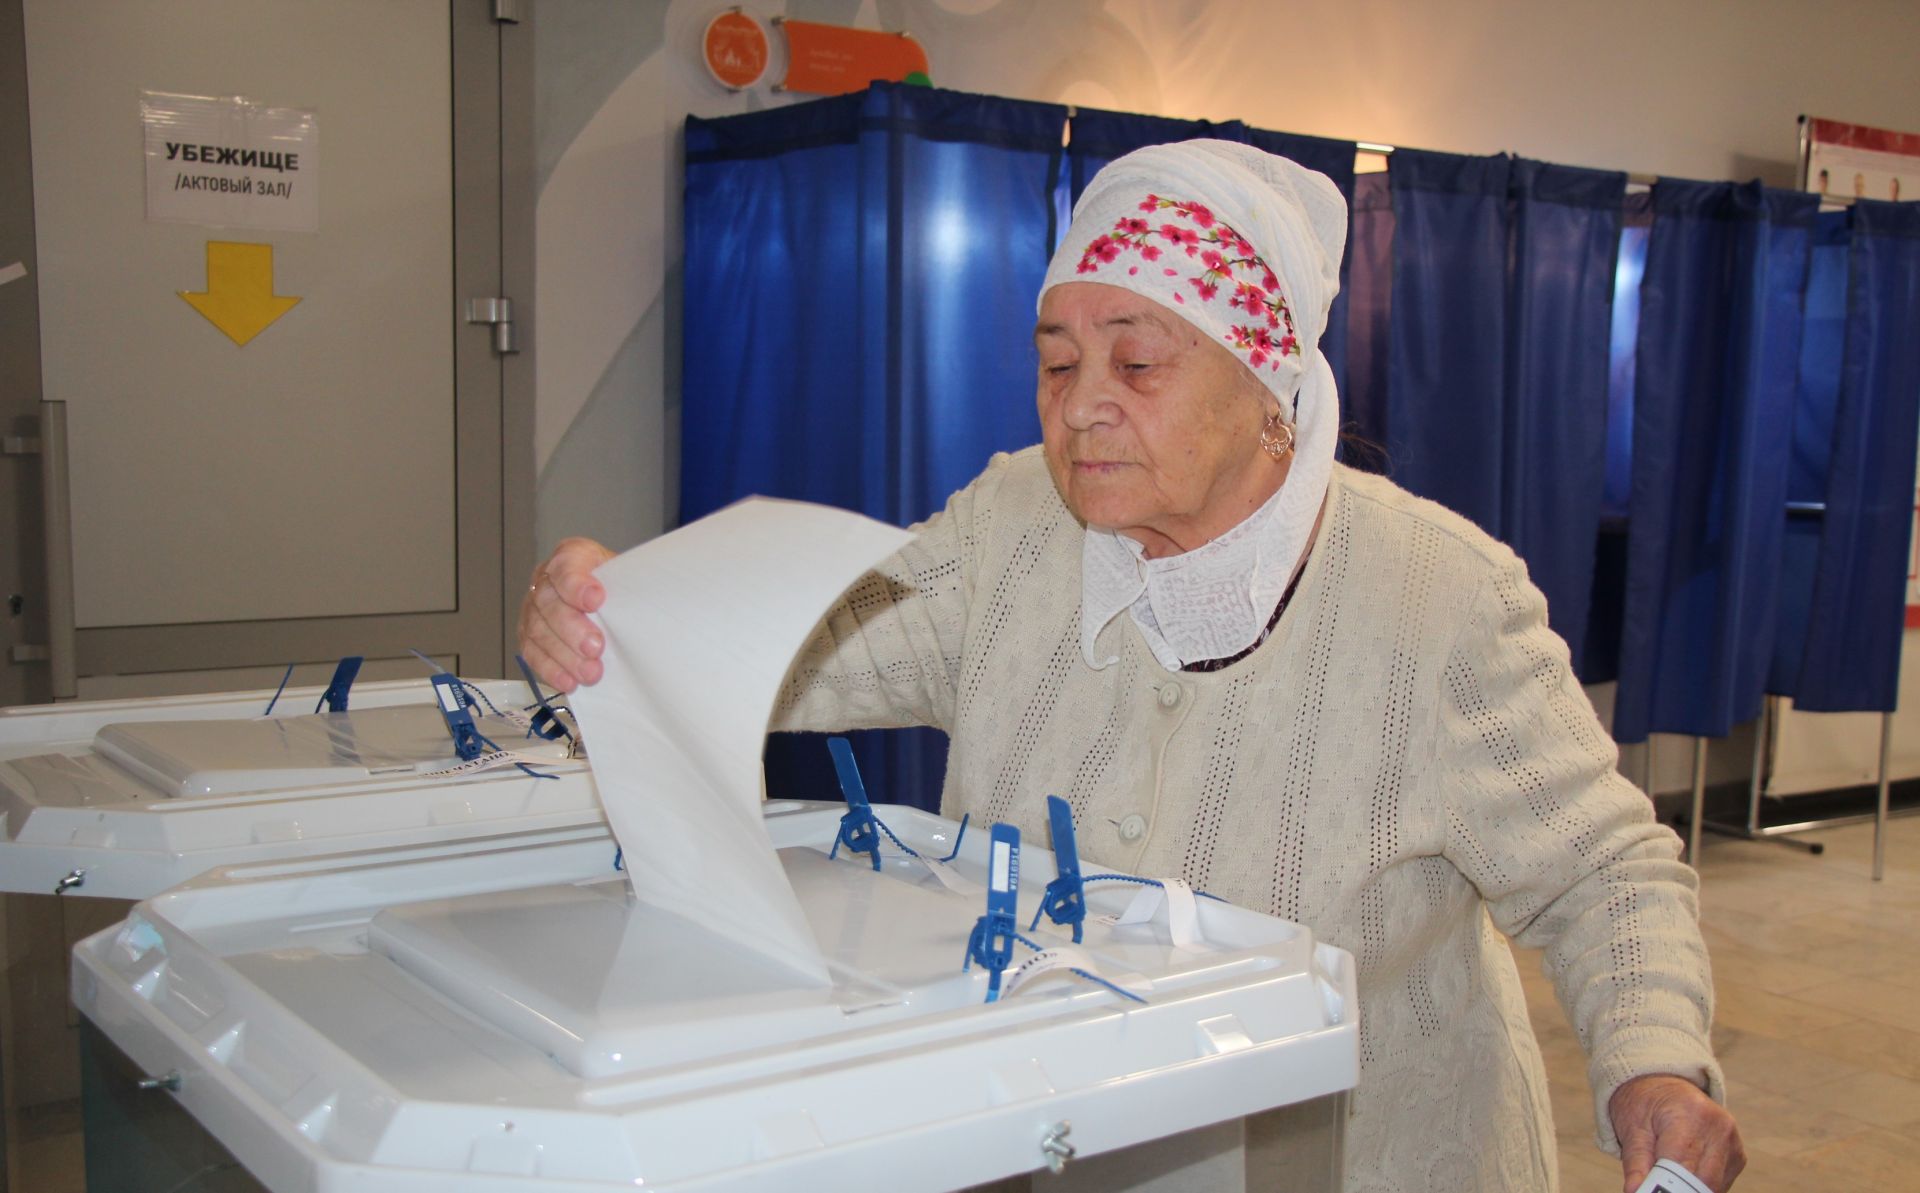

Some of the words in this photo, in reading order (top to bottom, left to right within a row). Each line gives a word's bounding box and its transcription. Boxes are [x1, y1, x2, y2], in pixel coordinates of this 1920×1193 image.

[166, 142, 299, 173] УБЕЖИЩЕ
[175, 173, 252, 195] /АКТОВЫЙ
[257, 180, 292, 199] ЗАЛ/
